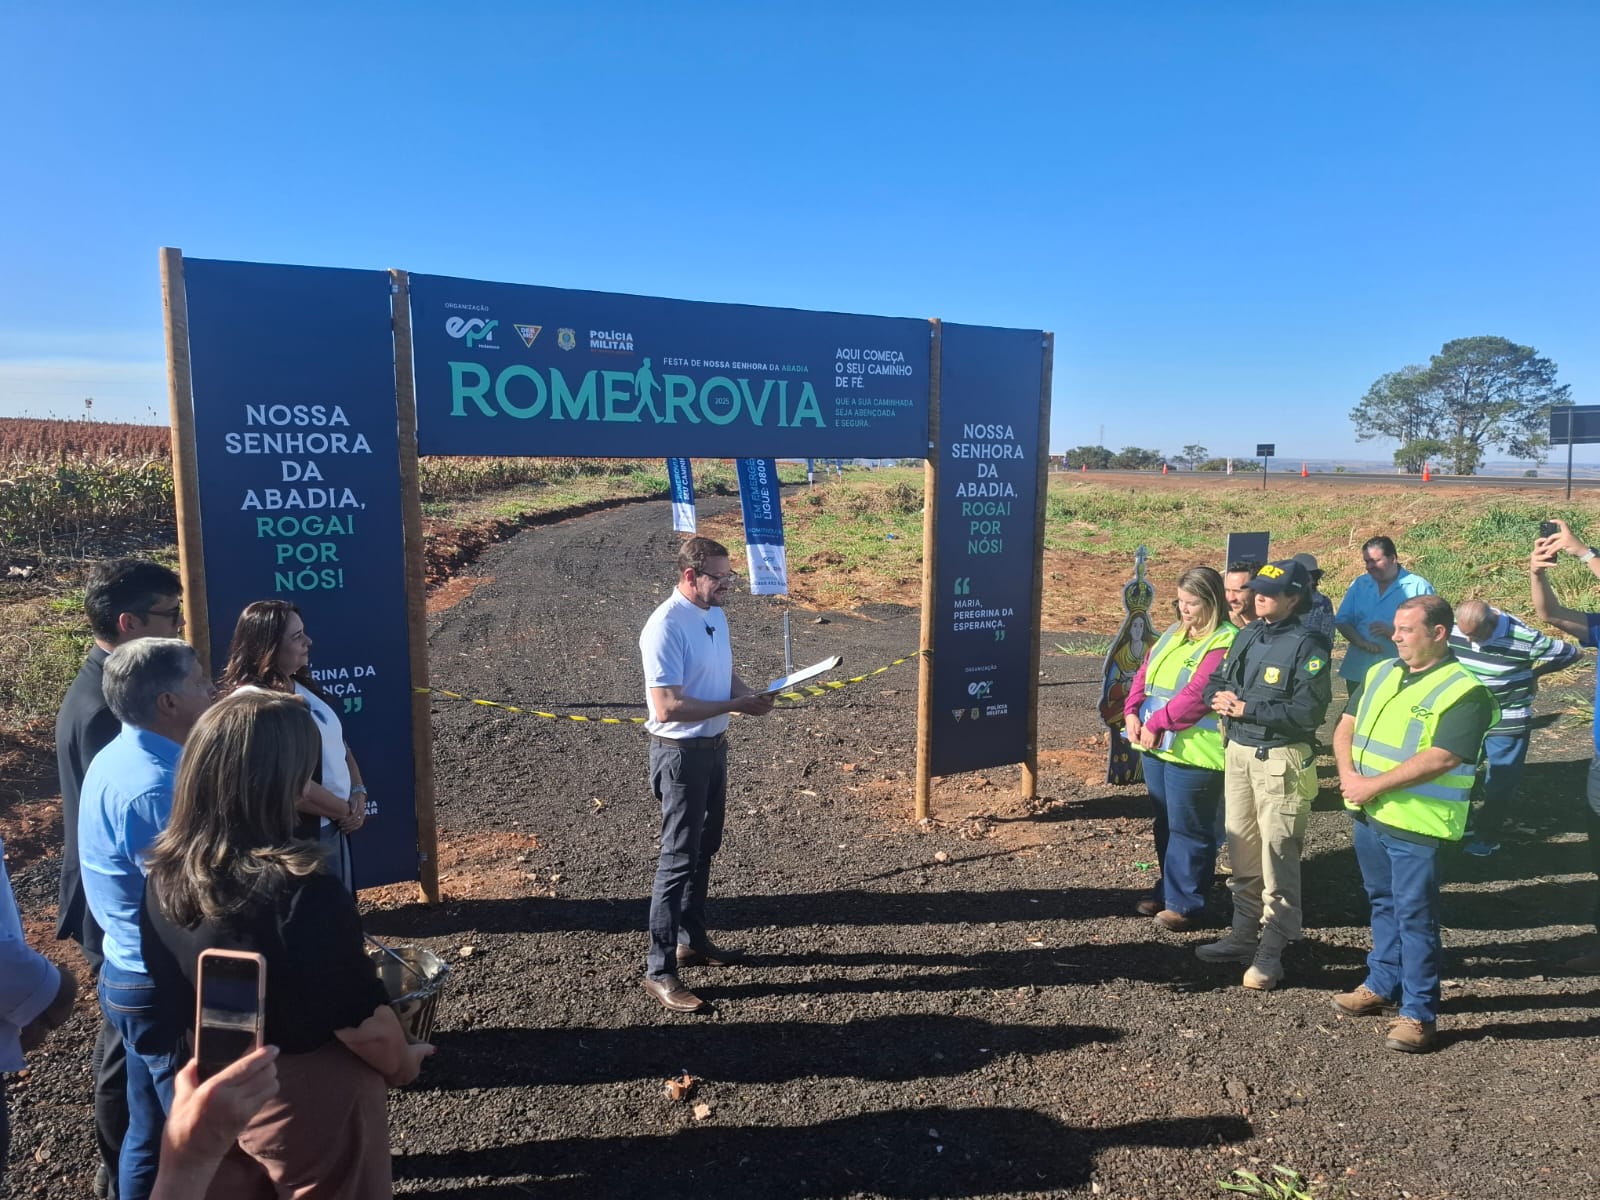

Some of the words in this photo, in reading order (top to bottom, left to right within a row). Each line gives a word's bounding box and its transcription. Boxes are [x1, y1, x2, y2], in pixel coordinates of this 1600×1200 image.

[589, 330, 634, 342] POLÍCIA
[589, 340, 634, 352] MILITAR
[835, 348, 860, 361] AQUI
[863, 349, 905, 364] COMEÇA
[663, 357, 689, 367] FESTA
[691, 359, 701, 367] DE
[703, 360, 730, 369] NOSSA
[732, 361, 767, 371] SENHORA
[769, 364, 780, 372] DA
[781, 364, 809, 373] ABADIA
[835, 362, 844, 373] O
[846, 362, 865, 374] SEU
[867, 364, 913, 376] CAMINHO
[835, 376, 849, 388] DE
[835, 397, 851, 406] QUE
[851, 398, 857, 406] A
[858, 398, 872, 406] SUA
[873, 398, 914, 407] CAMINHADA
[246, 404, 351, 426] NOSSA
[835, 408, 853, 417] SEJA
[835, 419, 841, 427] E
[963, 423, 1015, 440] NOSSA
[225, 432, 373, 454] SENHORA
[951, 443, 1024, 459] SENHORA
[281, 460, 324, 482] DA
[756, 459, 768, 485] 0800
[977, 463, 998, 478] DA
[955, 482, 1018, 499] ABADIA,
[240, 488, 366, 510] ABADIA,
[962, 501, 1011, 516] ROGAI
[256, 514, 355, 537] ROGAI
[970, 520, 1001, 535] POR
[968, 536, 1003, 554] NÓS!
[276, 542, 340, 565] POR
[274, 565, 344, 592] NÓS!
[954, 599, 983, 608] MARIA,
[953, 608, 1000, 620] PEREGRINA
[1001, 607, 1014, 617] DA
[353, 665, 376, 678] DA
